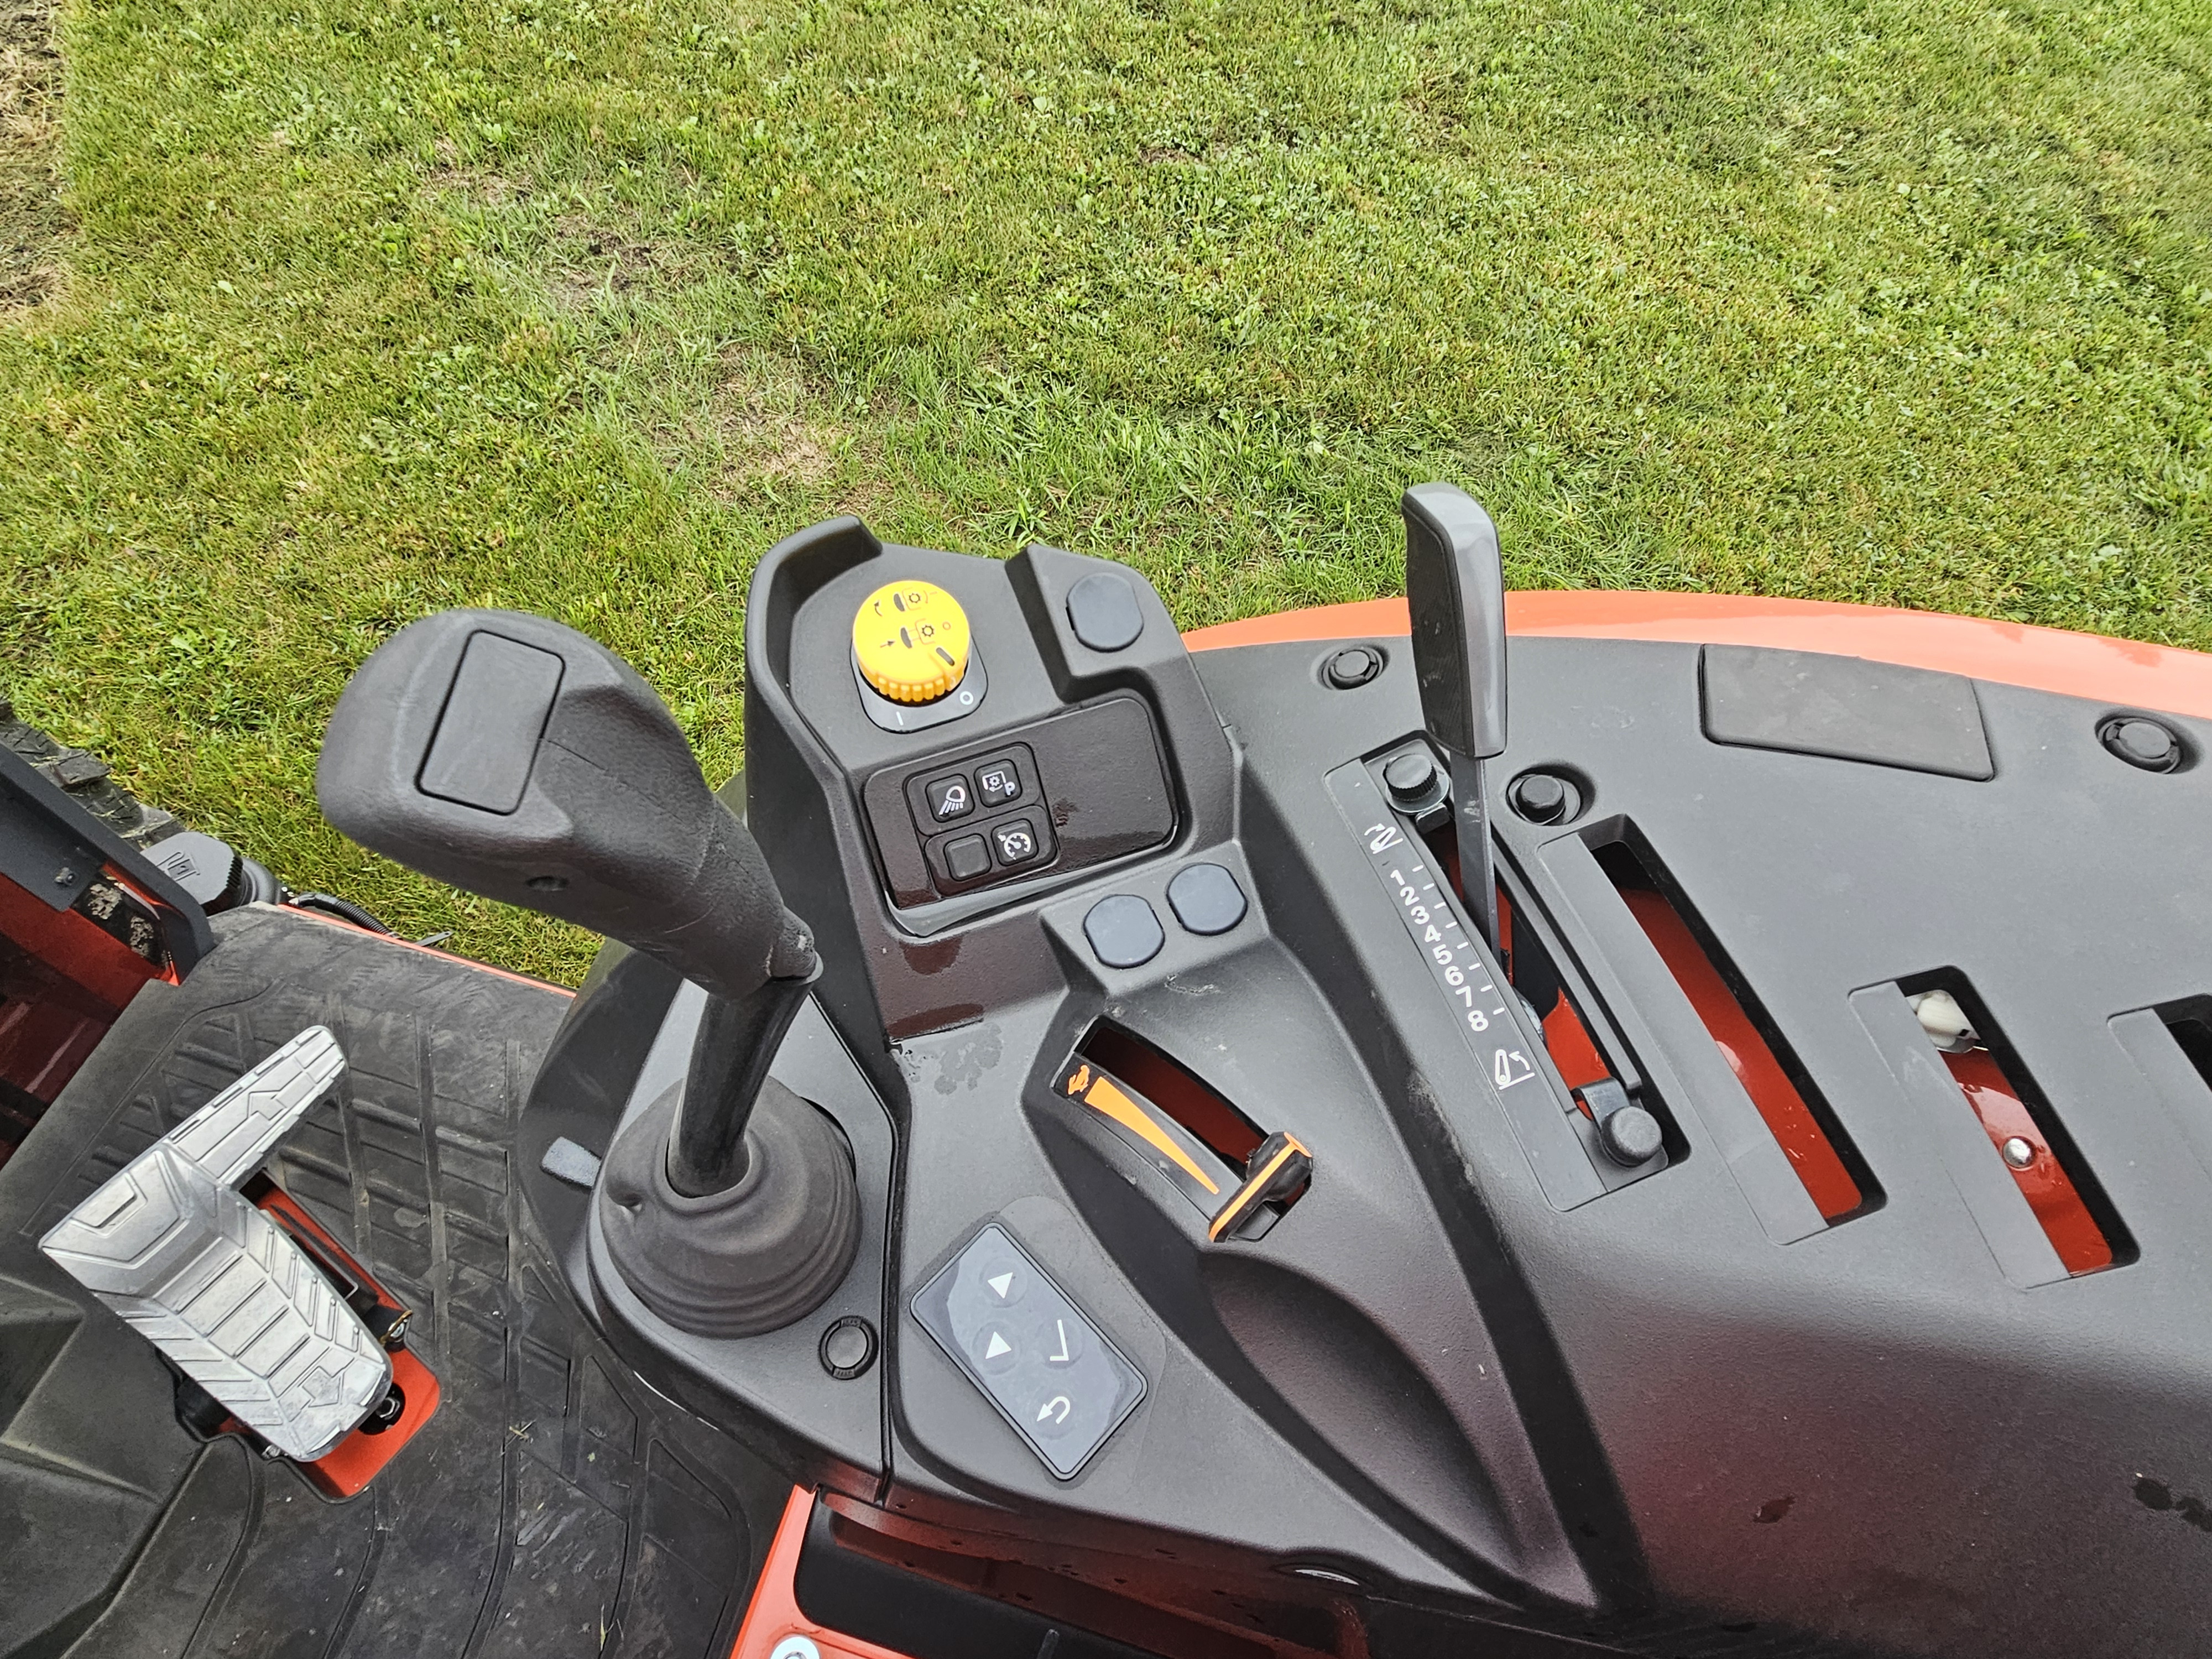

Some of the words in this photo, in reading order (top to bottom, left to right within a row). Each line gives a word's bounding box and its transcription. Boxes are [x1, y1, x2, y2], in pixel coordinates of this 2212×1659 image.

[1004, 781, 1015, 796] P
[1390, 869, 1405, 886] 1
[1400, 886, 1420, 906] 2
[1411, 906, 1430, 925] 3
[1425, 925, 1442, 942] 4
[1432, 944, 1452, 965] 5
[1444, 966, 1464, 986] 6
[1455, 985, 1472, 1008] 7
[1468, 1010, 1489, 1031] 8
